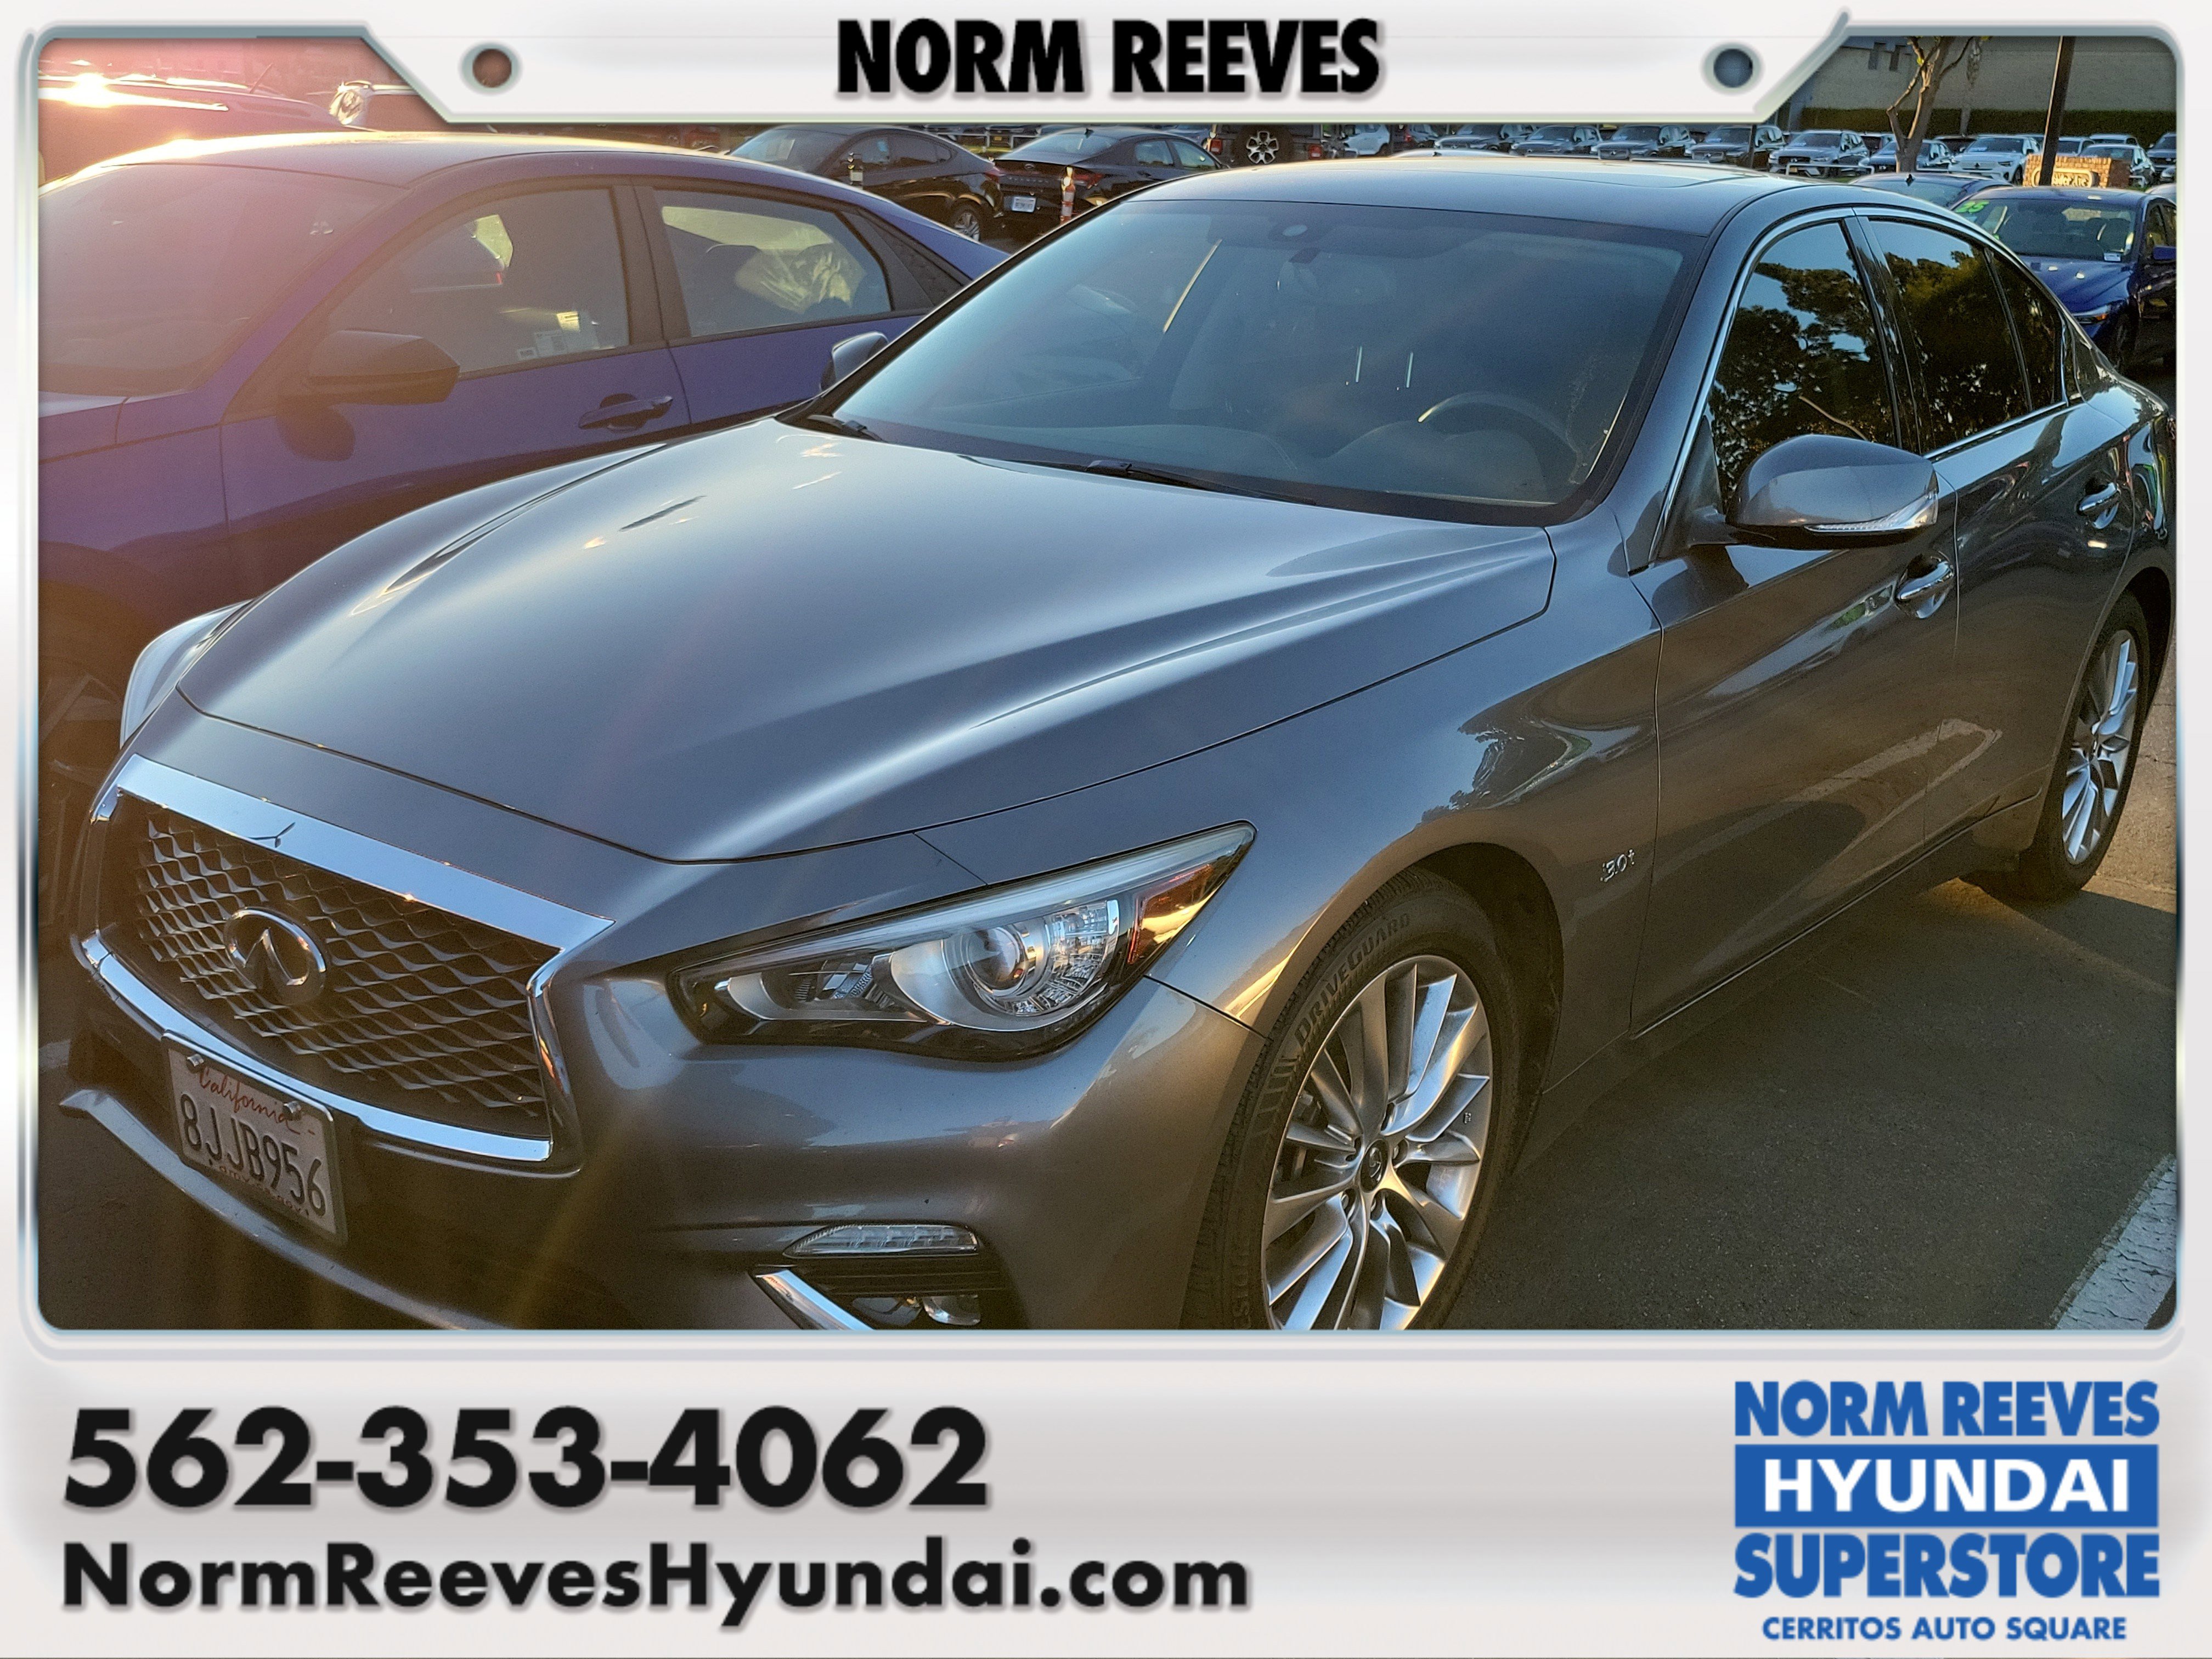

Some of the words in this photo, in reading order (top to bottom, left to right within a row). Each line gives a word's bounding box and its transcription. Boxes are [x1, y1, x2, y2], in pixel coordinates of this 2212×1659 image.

[1294, 913, 1412, 1048] DRIVEGUARD
[180, 1093, 327, 1217] 8JJB956
[198, 1065, 301, 1135] California
